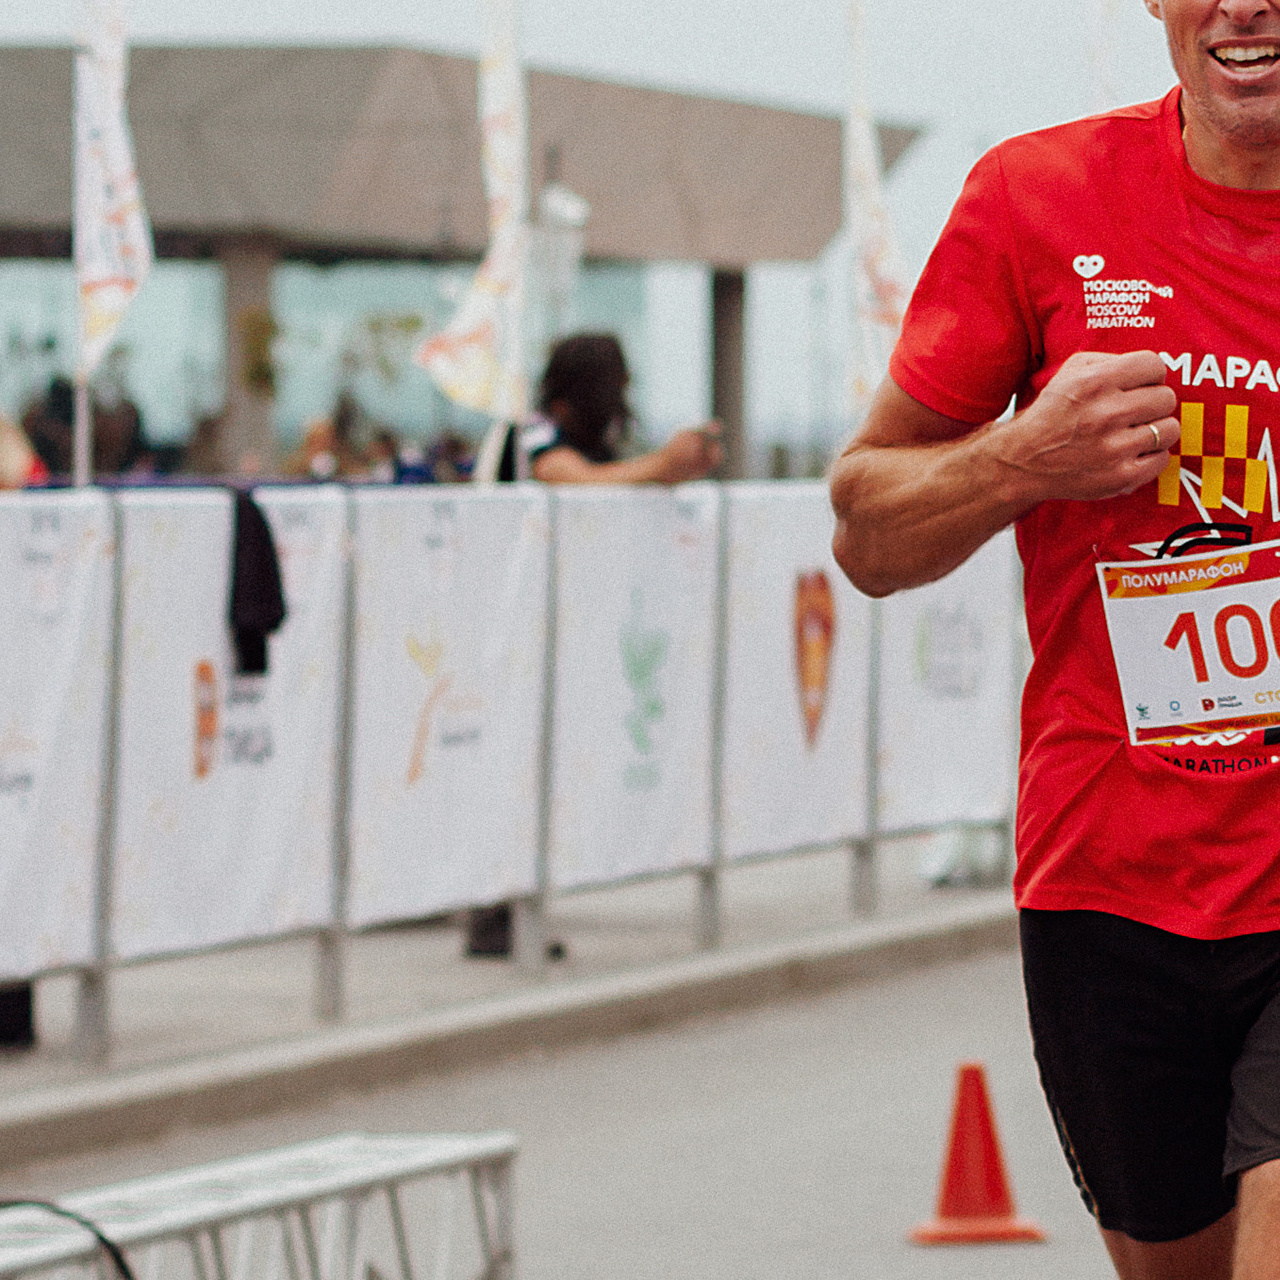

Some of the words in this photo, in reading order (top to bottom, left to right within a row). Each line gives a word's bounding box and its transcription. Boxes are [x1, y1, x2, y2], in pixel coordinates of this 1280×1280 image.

[1084, 291, 1150, 305] МАРАФОН
[1086, 304, 1142, 317] MOSCOW
[1086, 316, 1155, 329] MARATHON
[1121, 561, 1245, 588] ПОЛУМАРАФОН
